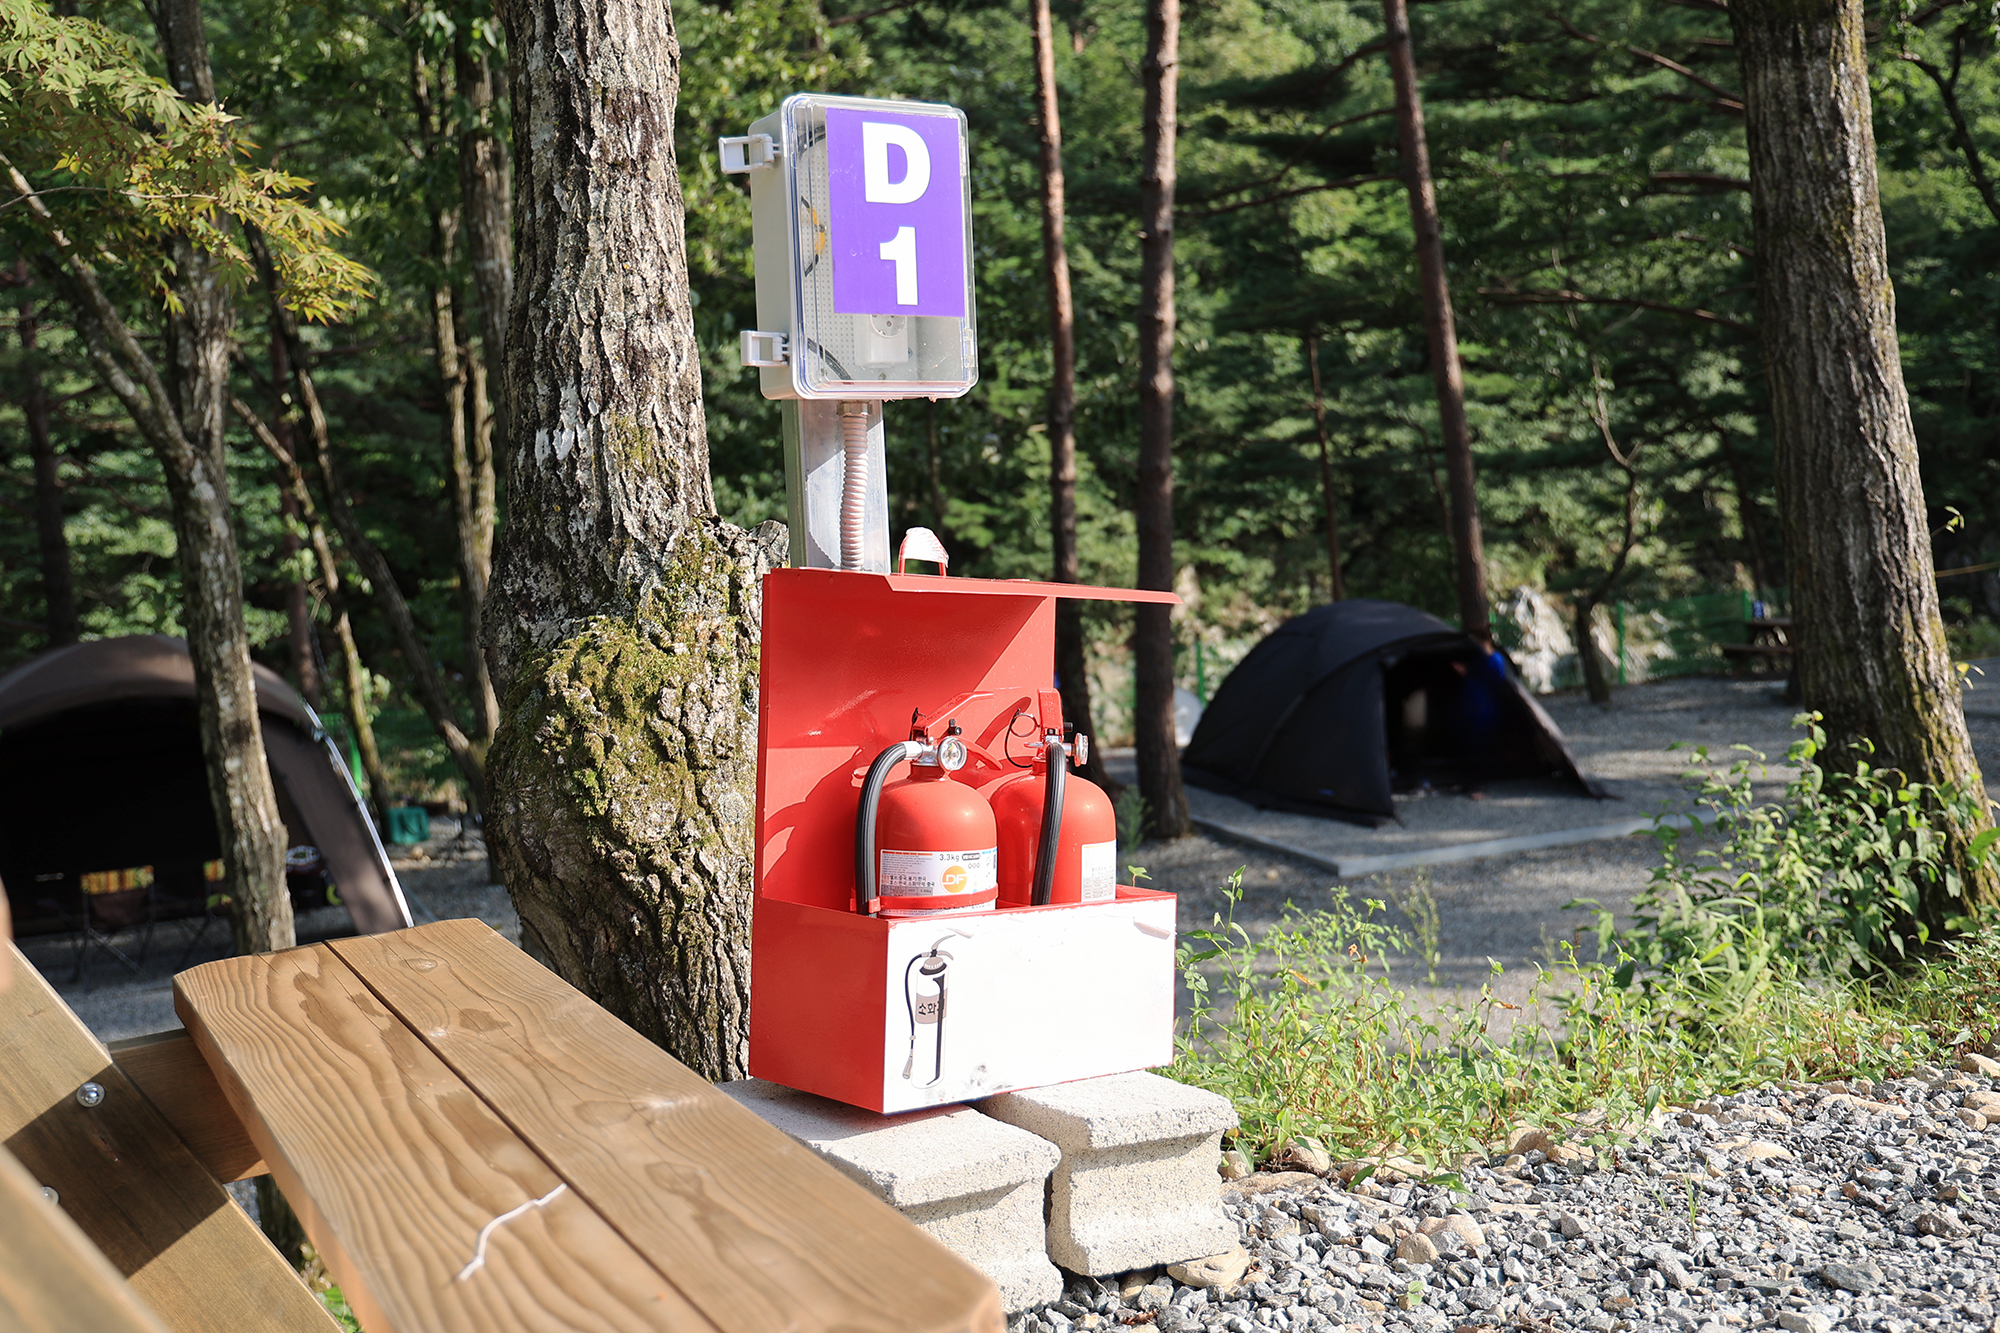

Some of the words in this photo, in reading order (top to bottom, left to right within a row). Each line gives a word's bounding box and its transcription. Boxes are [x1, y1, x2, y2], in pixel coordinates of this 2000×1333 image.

[862, 121, 931, 204] D
[879, 226, 919, 306] 1
[939, 853, 960, 862] 3.3kg
[943, 874, 967, 885] DF
